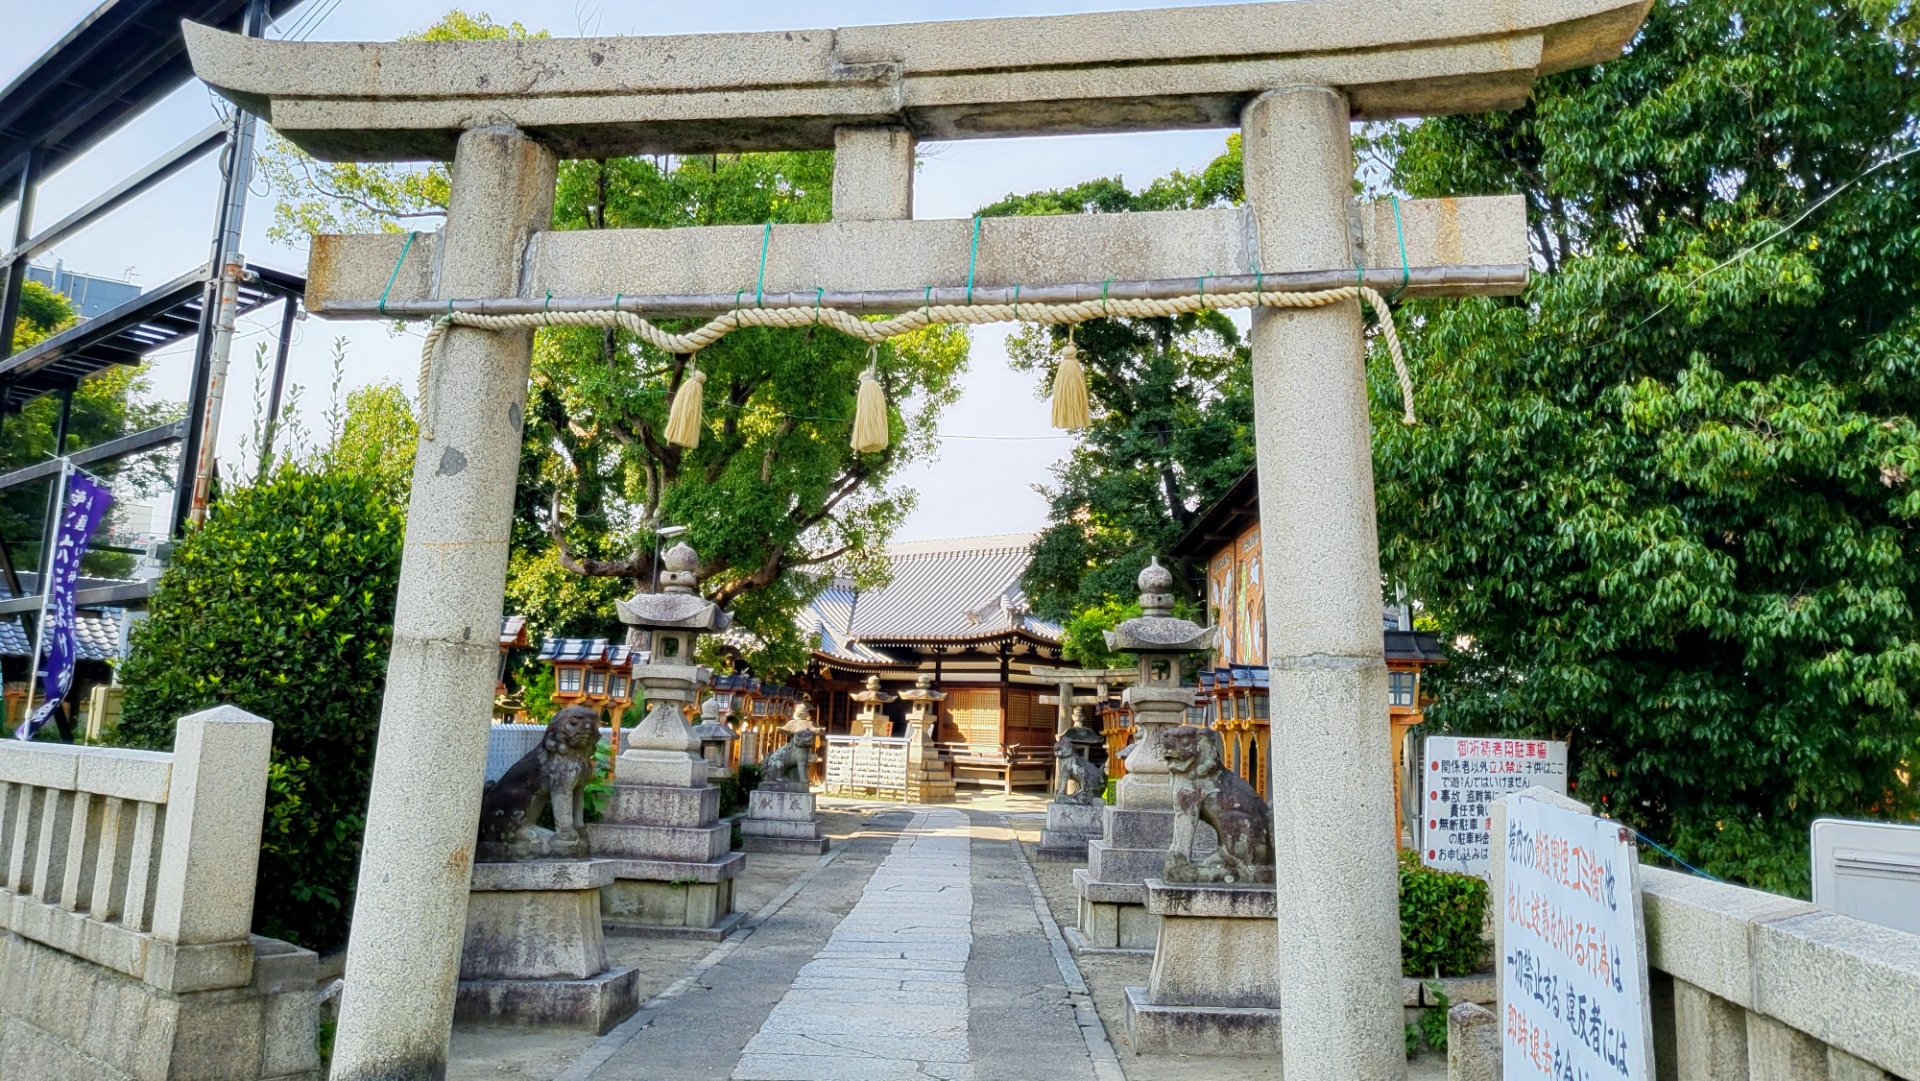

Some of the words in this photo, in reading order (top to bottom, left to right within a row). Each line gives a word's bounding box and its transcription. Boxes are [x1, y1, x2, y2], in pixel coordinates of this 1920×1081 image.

[1441, 789, 1460, 803] 事故
[1439, 818, 1478, 831] 無断駐車
[1449, 833, 1492, 845] の駐車料金
[1438, 849, 1488, 861] お申し込みは
